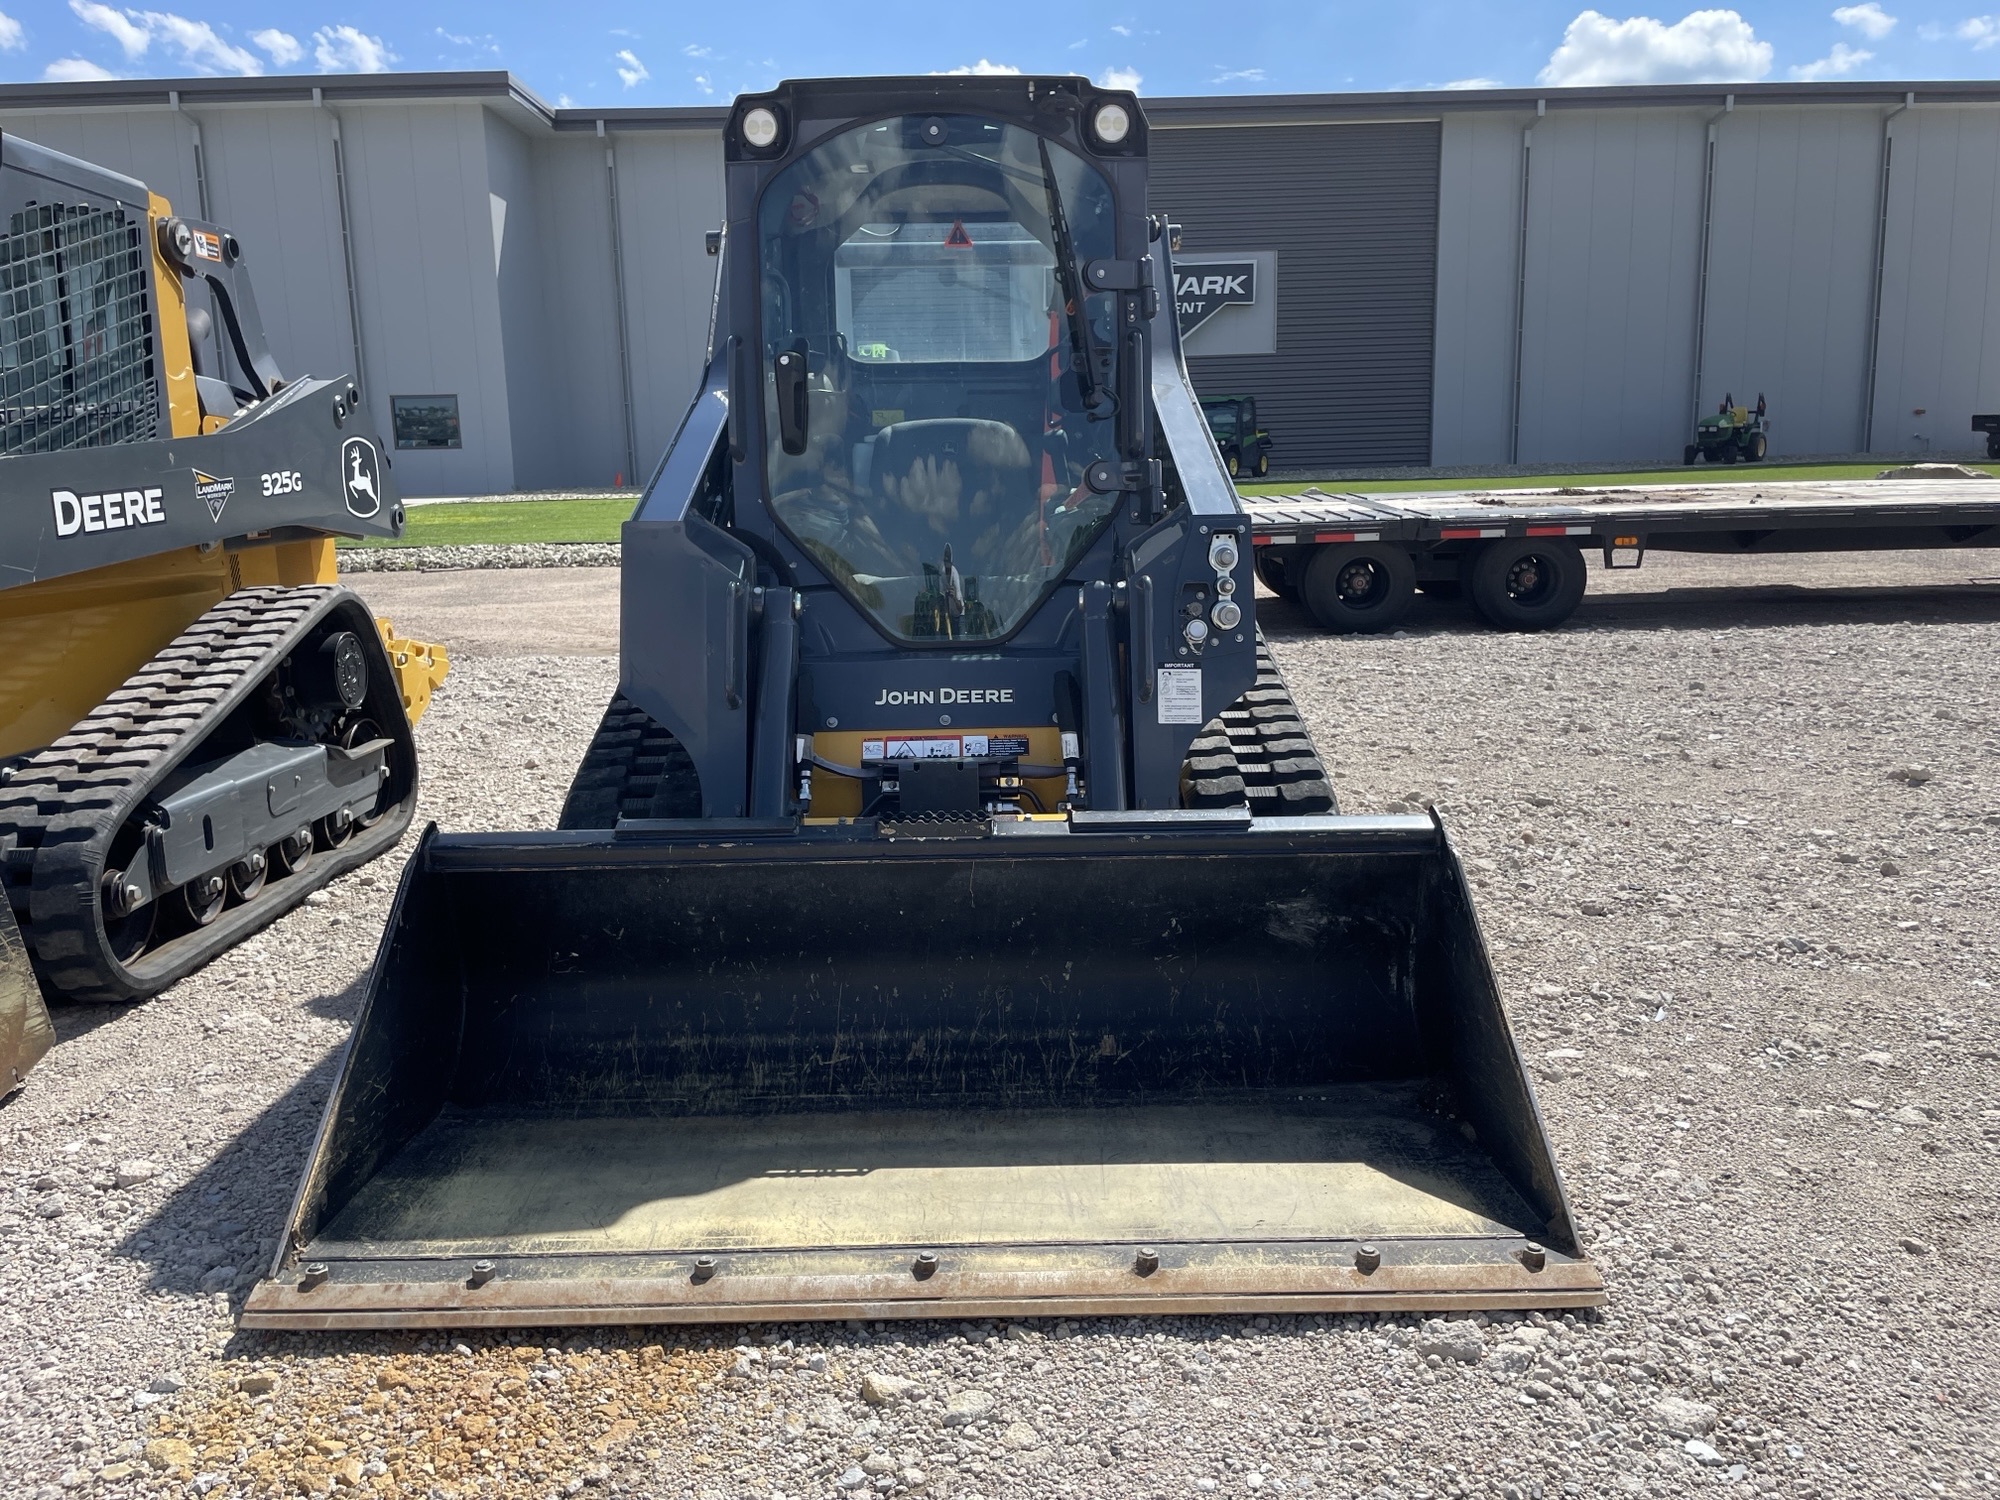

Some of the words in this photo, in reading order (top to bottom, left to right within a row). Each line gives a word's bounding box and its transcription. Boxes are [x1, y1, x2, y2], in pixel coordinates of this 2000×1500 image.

[197, 483, 233, 495] LANDMARK
[261, 470, 303, 497] 325G
[52, 487, 165, 537] DEERE
[875, 688, 934, 705] JOHN
[940, 687, 1014, 704] DEERE
